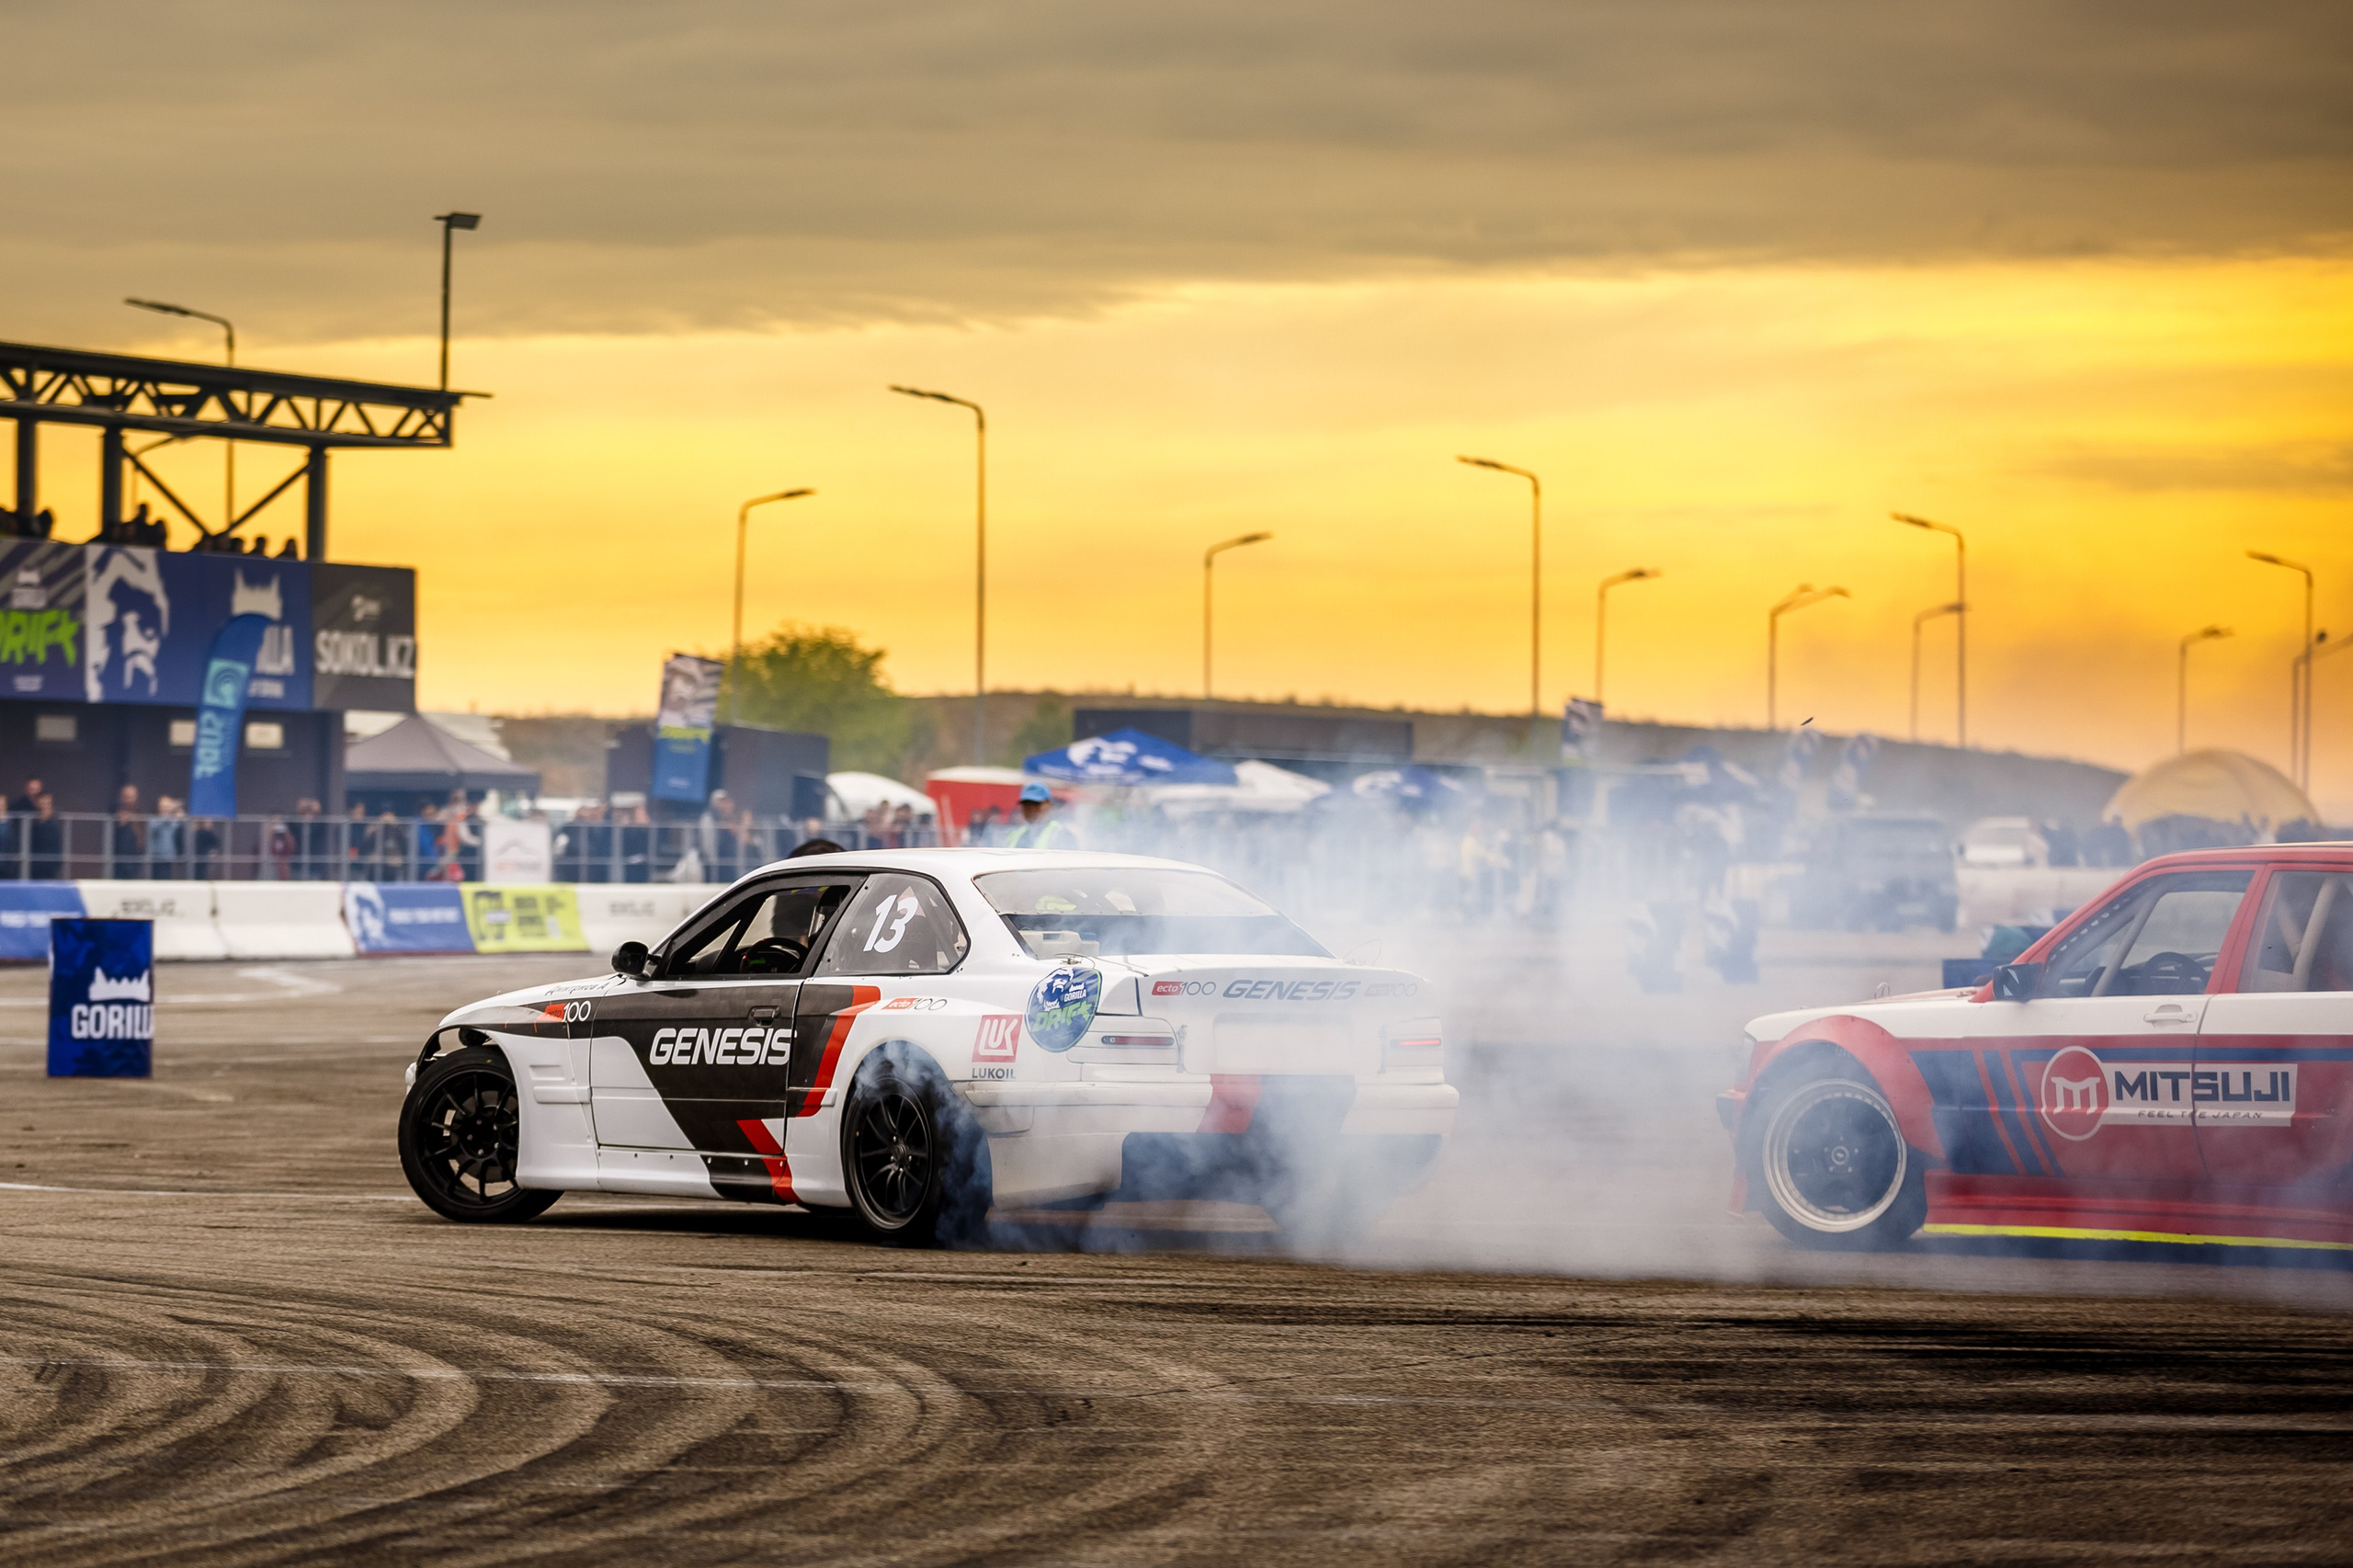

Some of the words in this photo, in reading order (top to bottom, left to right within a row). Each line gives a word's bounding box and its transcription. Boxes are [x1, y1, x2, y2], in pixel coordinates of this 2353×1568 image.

[863, 894, 919, 953] 13
[1063, 988, 1087, 1003] GORILLA
[1222, 979, 1362, 1001] GENESIS
[649, 1028, 798, 1065] GENESIS
[972, 1067, 1017, 1079] LUKOIL
[2114, 1070, 2290, 1102] MITSUJI
[2138, 1109, 2175, 1119] FEEL
[2211, 1111, 2263, 1119] JAPAN
